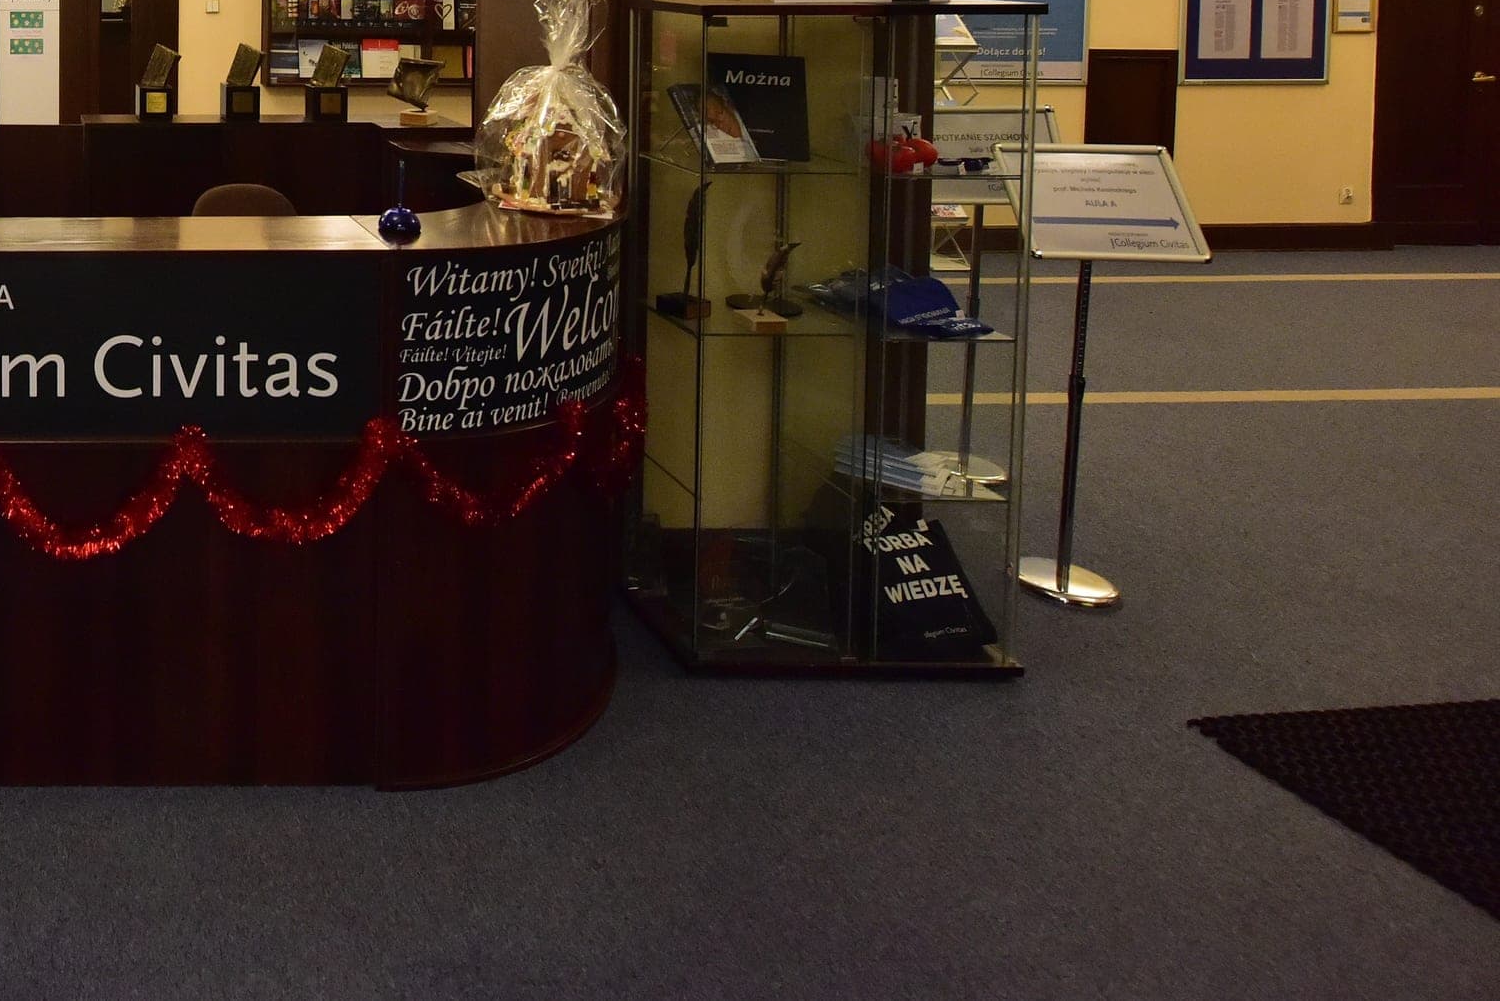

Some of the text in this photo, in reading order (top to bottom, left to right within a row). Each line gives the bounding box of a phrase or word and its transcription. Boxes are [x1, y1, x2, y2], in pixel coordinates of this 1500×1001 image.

[1026, 47, 1046, 56] ns!
[724, 69, 792, 87] Można
[406, 240, 604, 302] Witamy! Sveiki!
[401, 305, 501, 342] Fáilte!
[94, 334, 339, 398] Civitas
[400, 346, 449, 364] Fáilte!
[398, 366, 496, 411] Добро
[398, 391, 549, 432] Bine ai venit!
[895, 553, 931, 576] NA
[883, 574, 969, 605] WIEDZĘ
